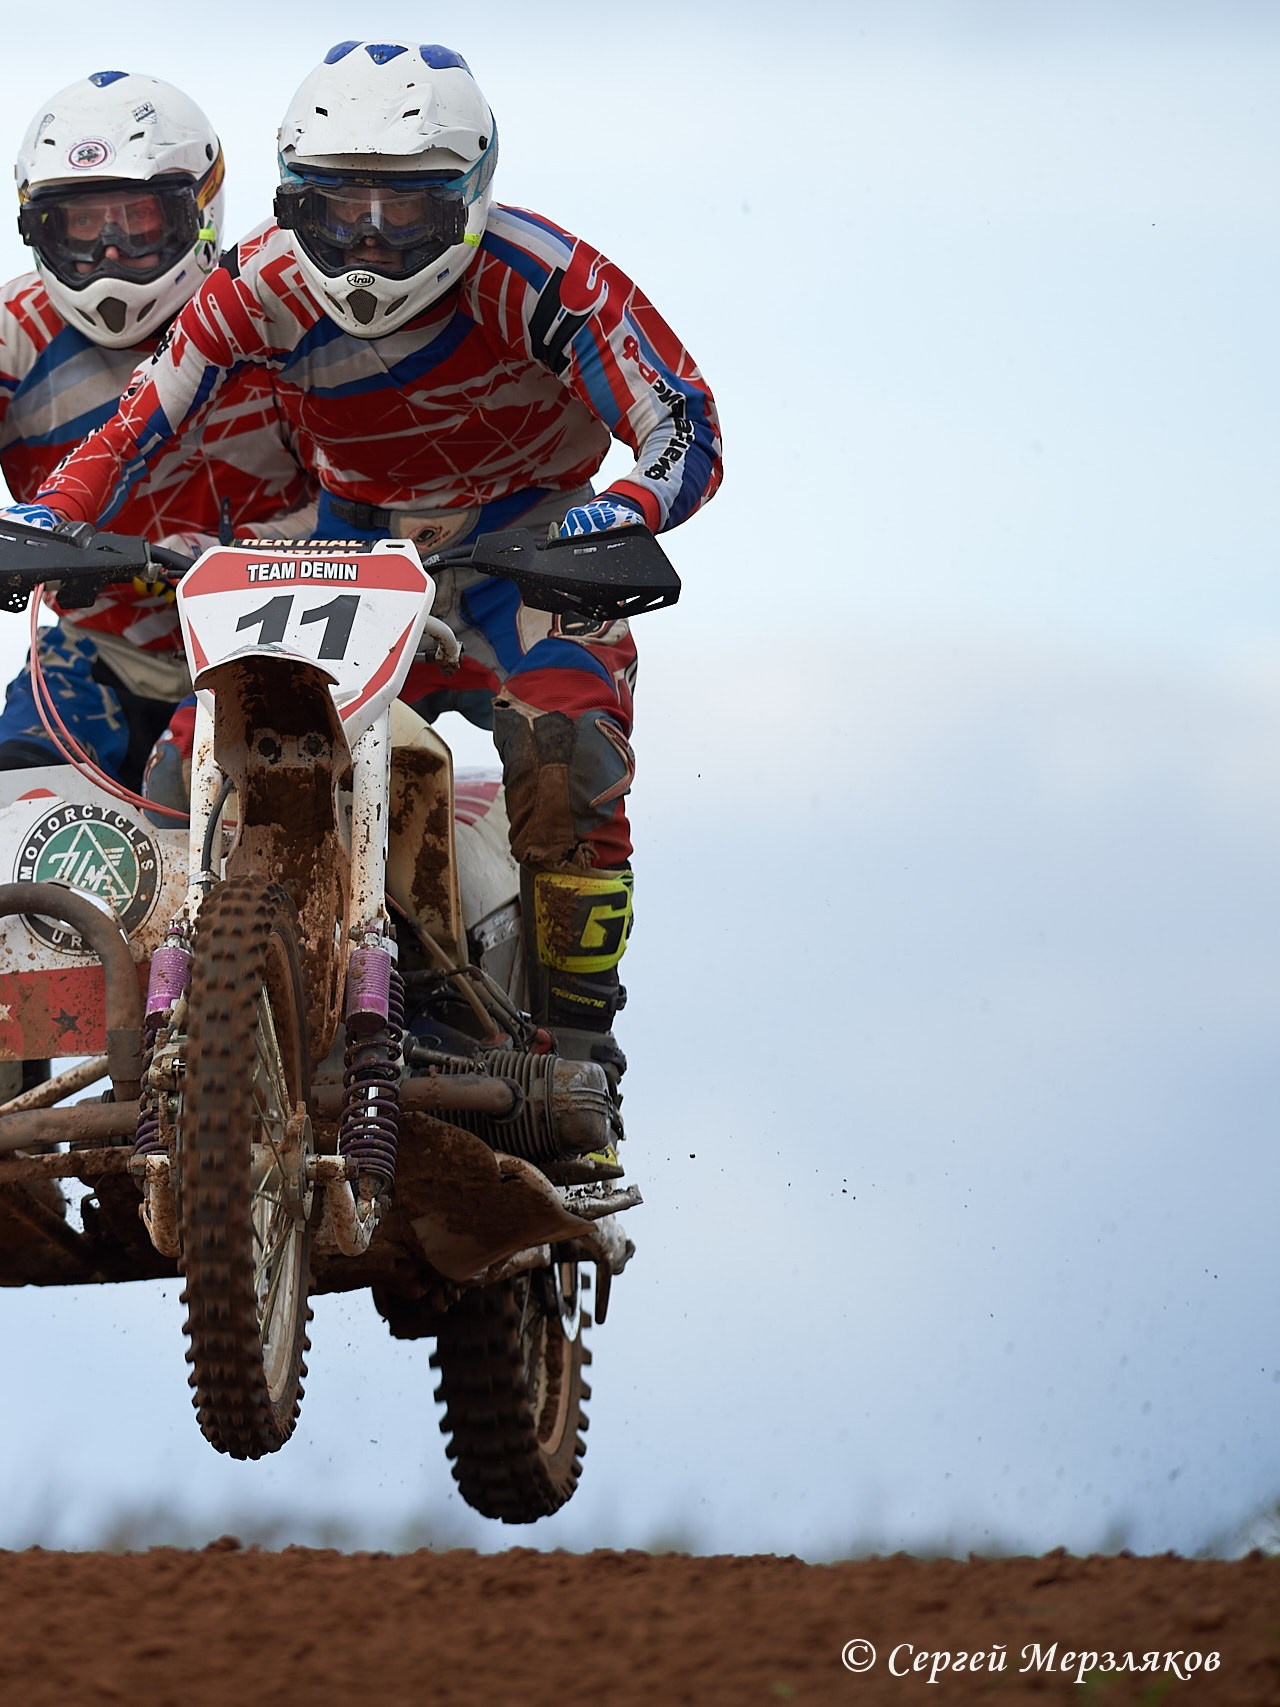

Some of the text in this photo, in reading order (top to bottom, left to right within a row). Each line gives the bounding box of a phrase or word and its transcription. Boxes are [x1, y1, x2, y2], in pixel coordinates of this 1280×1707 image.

[247, 560, 359, 582] TEAM DEMIN
[235, 594, 361, 660] 11
[19, 805, 154, 880] MOTORCYCLES
